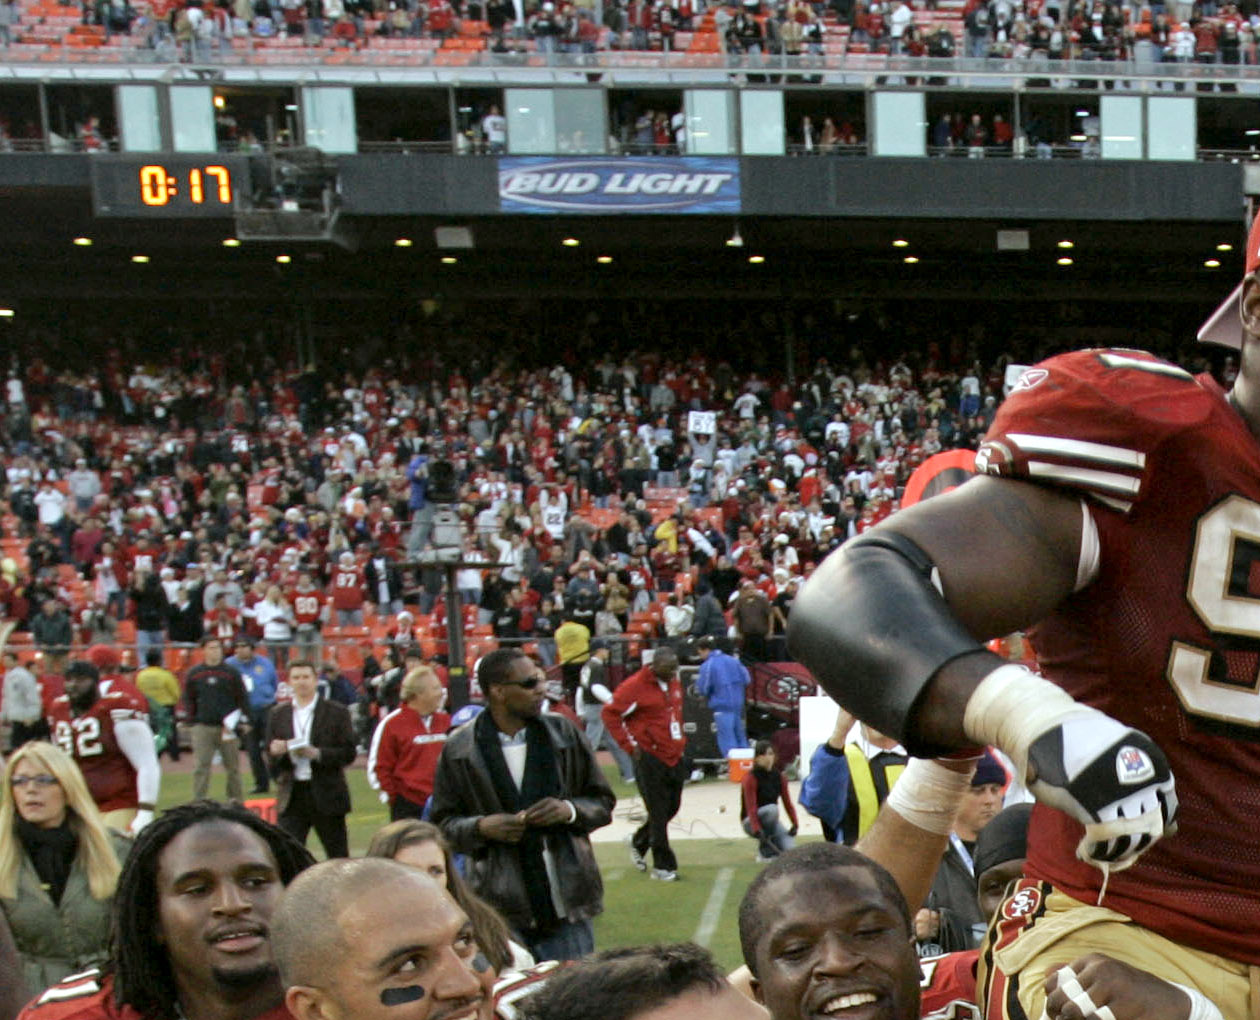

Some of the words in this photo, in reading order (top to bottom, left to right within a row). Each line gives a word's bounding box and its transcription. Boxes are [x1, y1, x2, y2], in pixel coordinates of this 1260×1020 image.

[140, 164, 233, 206] 0:17
[508, 172, 600, 194] BUD
[604, 173, 732, 195] LIGHT
